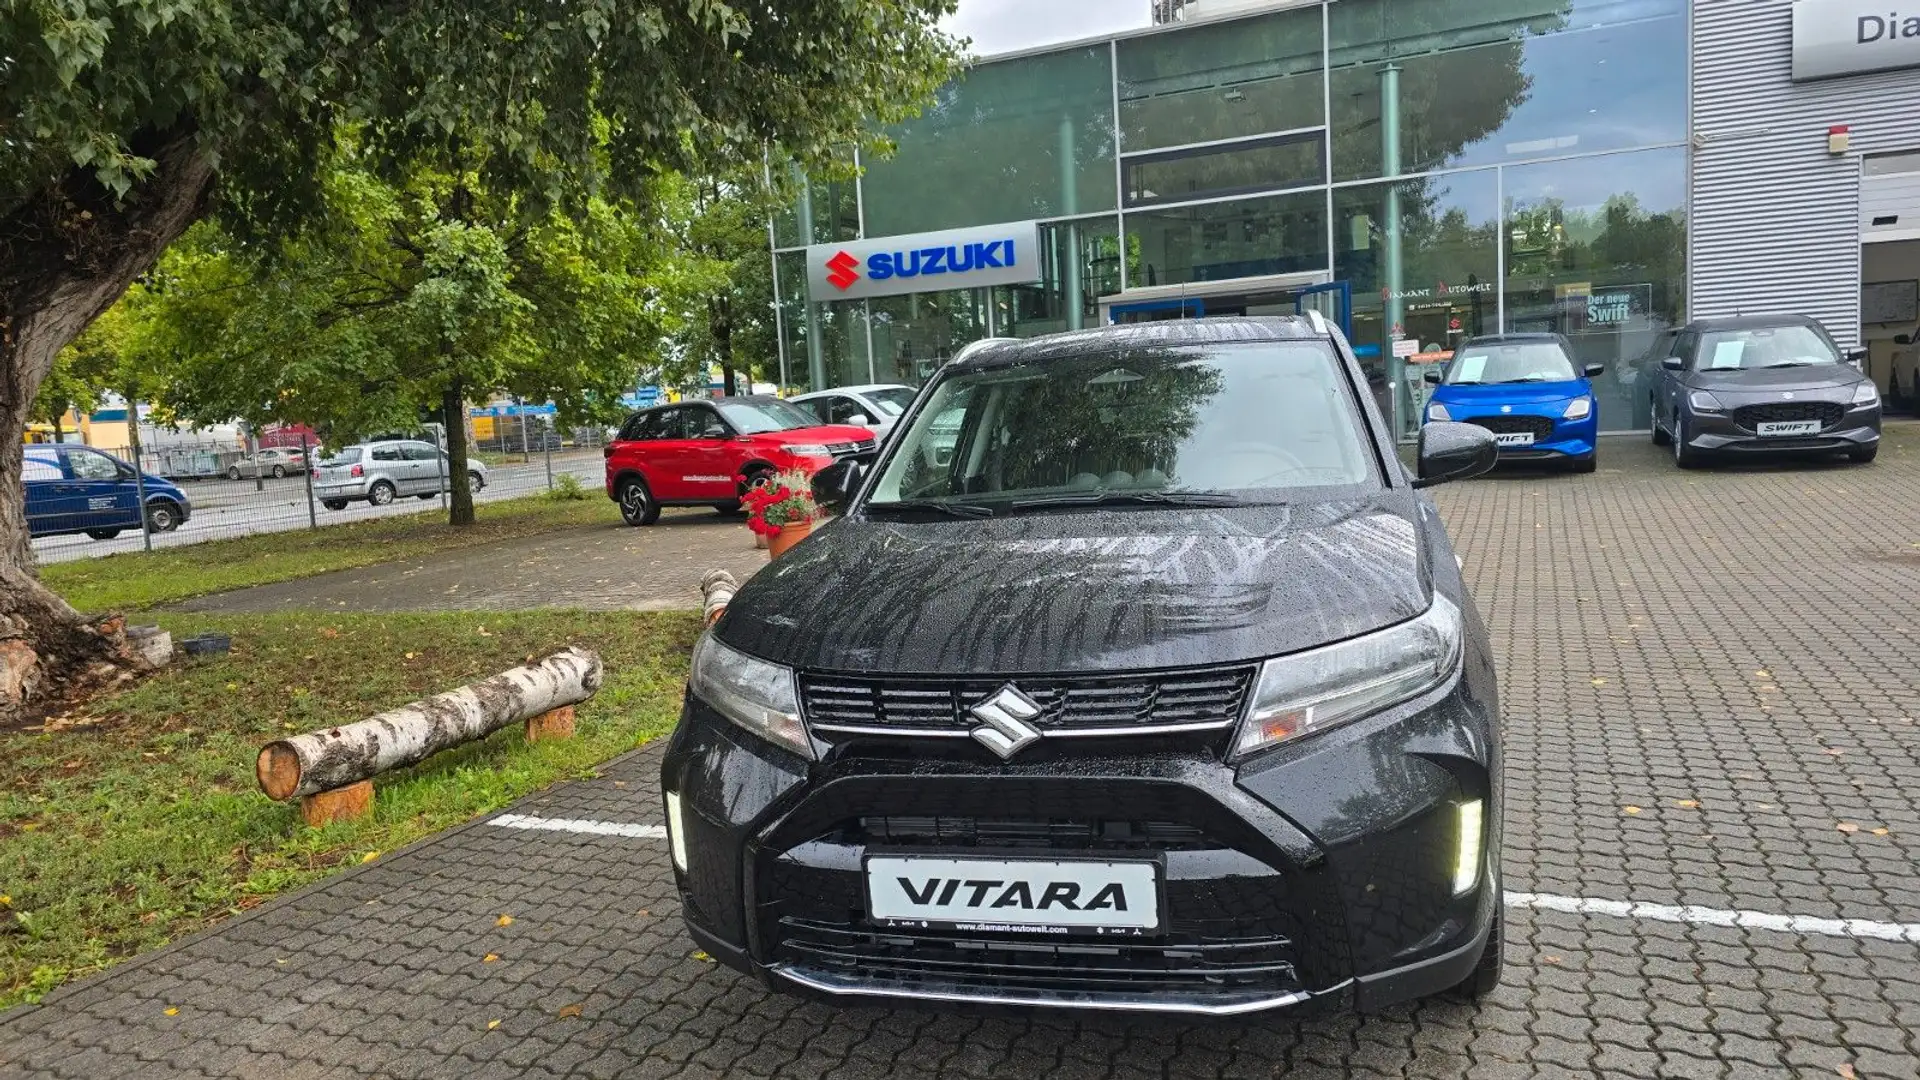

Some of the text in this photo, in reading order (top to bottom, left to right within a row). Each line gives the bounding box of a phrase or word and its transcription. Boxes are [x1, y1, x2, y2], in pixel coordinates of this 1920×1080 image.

[1857, 12, 1920, 44] Dia
[867, 240, 1015, 280] SUZUKI
[1587, 293, 1630, 305] Der neue
[1587, 303, 1630, 323] Swift
[1763, 423, 1815, 432] SWIFT
[896, 876, 1129, 912] VITARA
[955, 922, 1069, 935] www.diamant-autowelt.com
